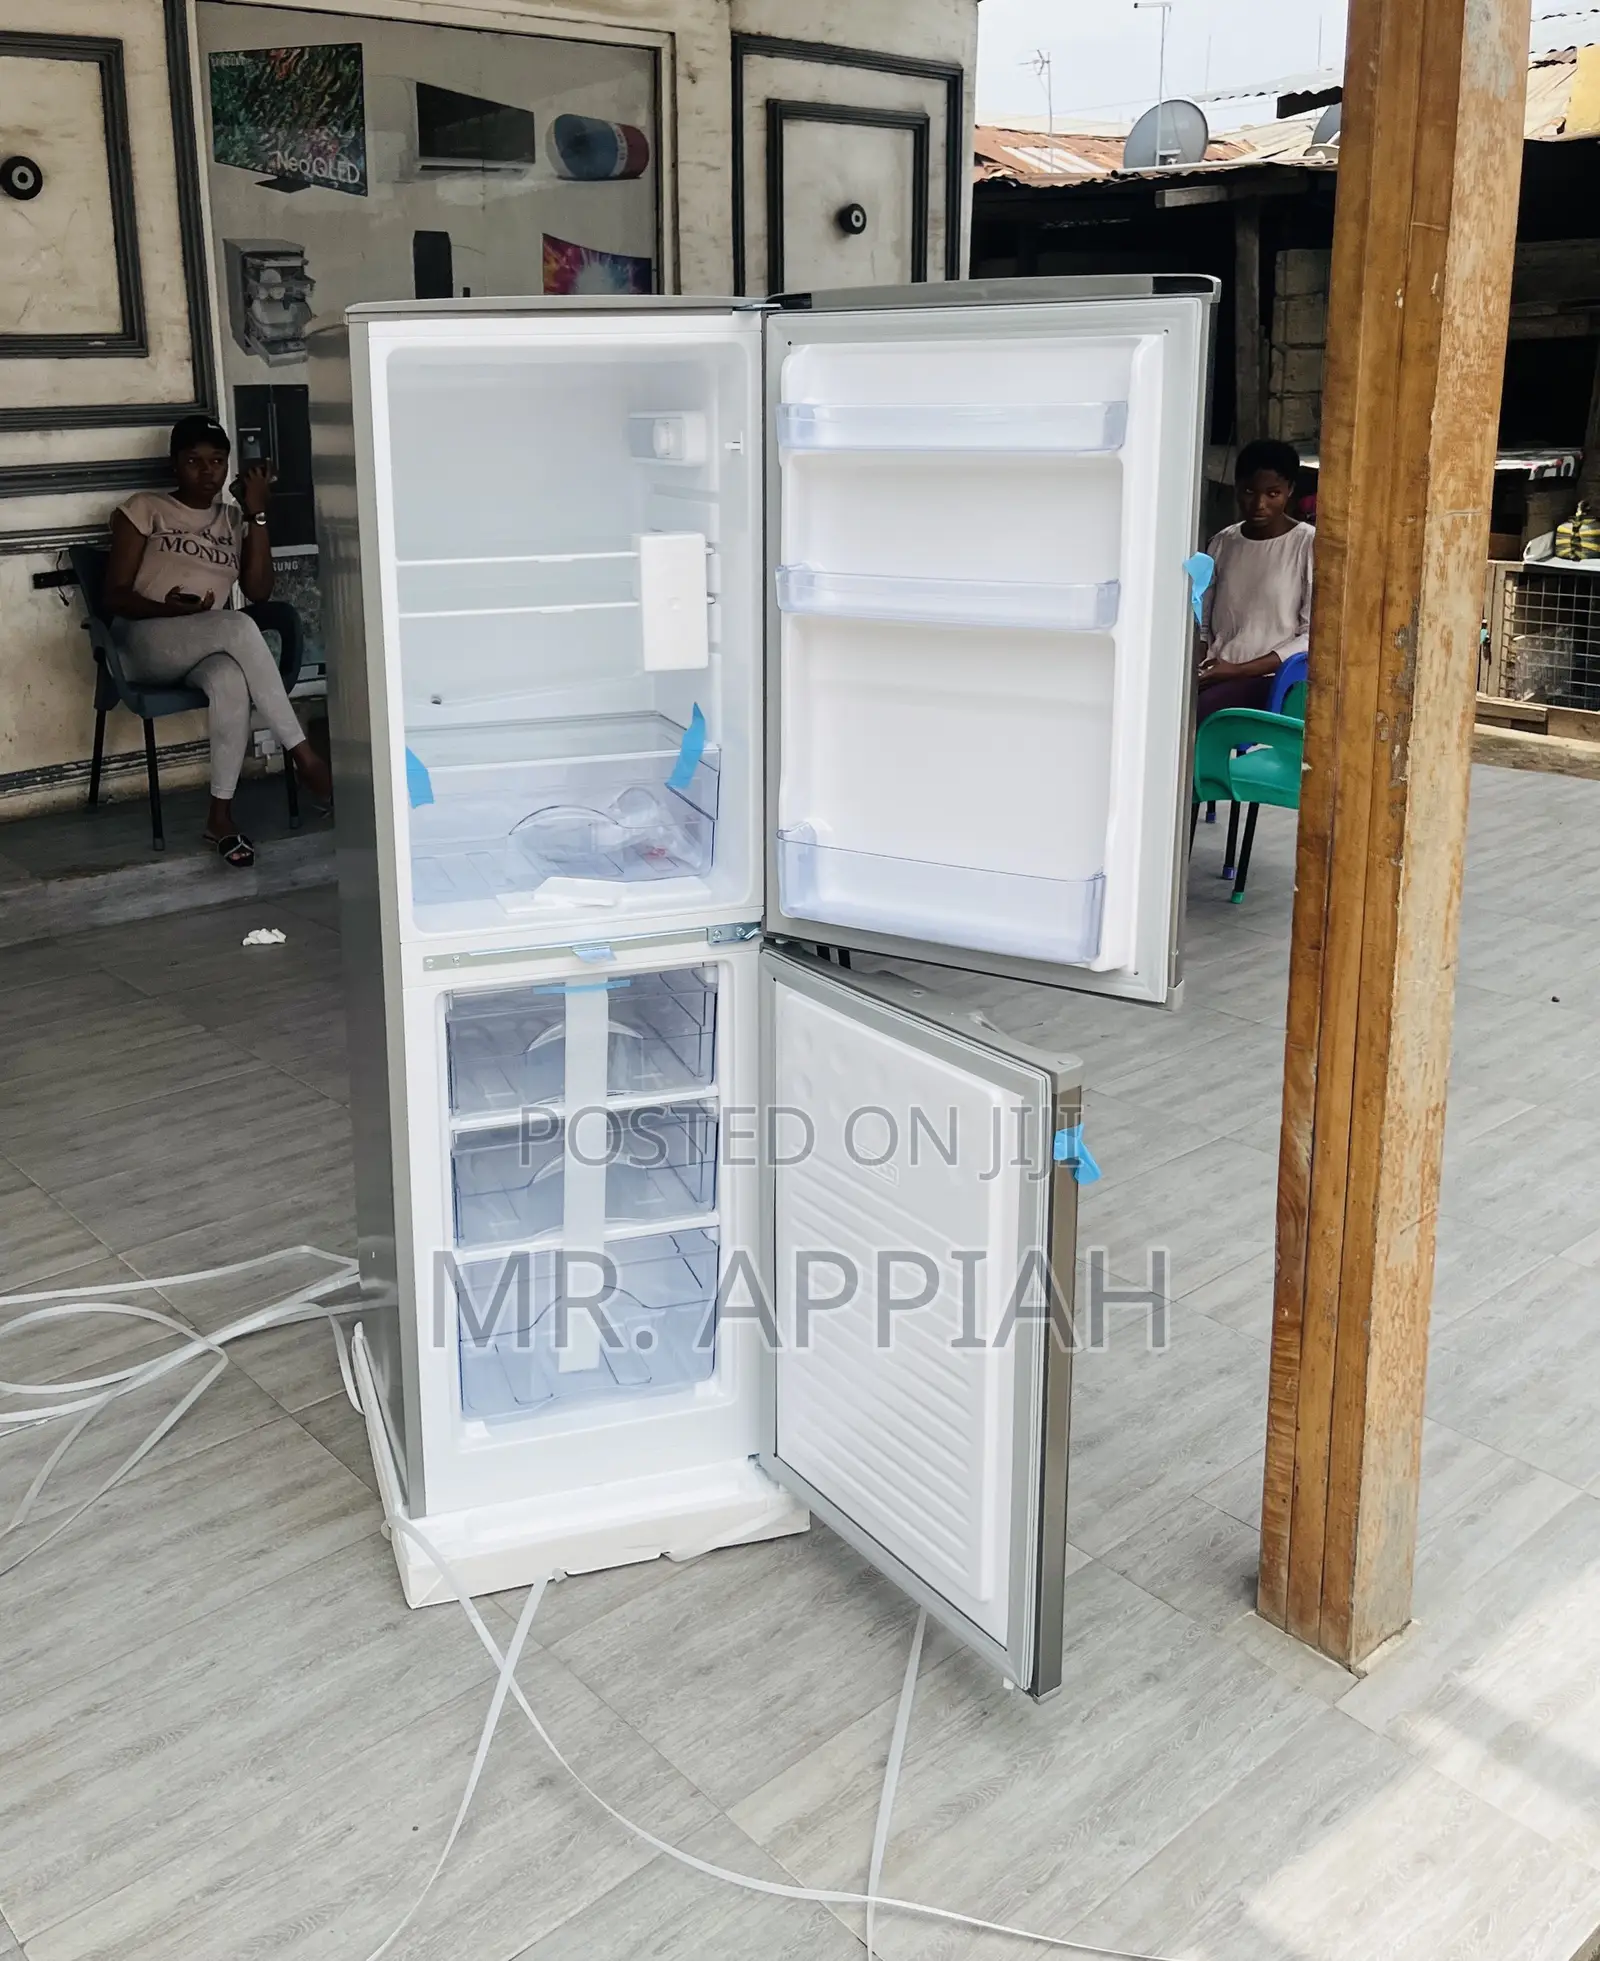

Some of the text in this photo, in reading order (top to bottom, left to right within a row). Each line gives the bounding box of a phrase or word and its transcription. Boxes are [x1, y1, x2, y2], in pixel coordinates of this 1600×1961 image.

[276, 151, 360, 184] Neo QLED
[157, 536, 240, 571] MONDA
